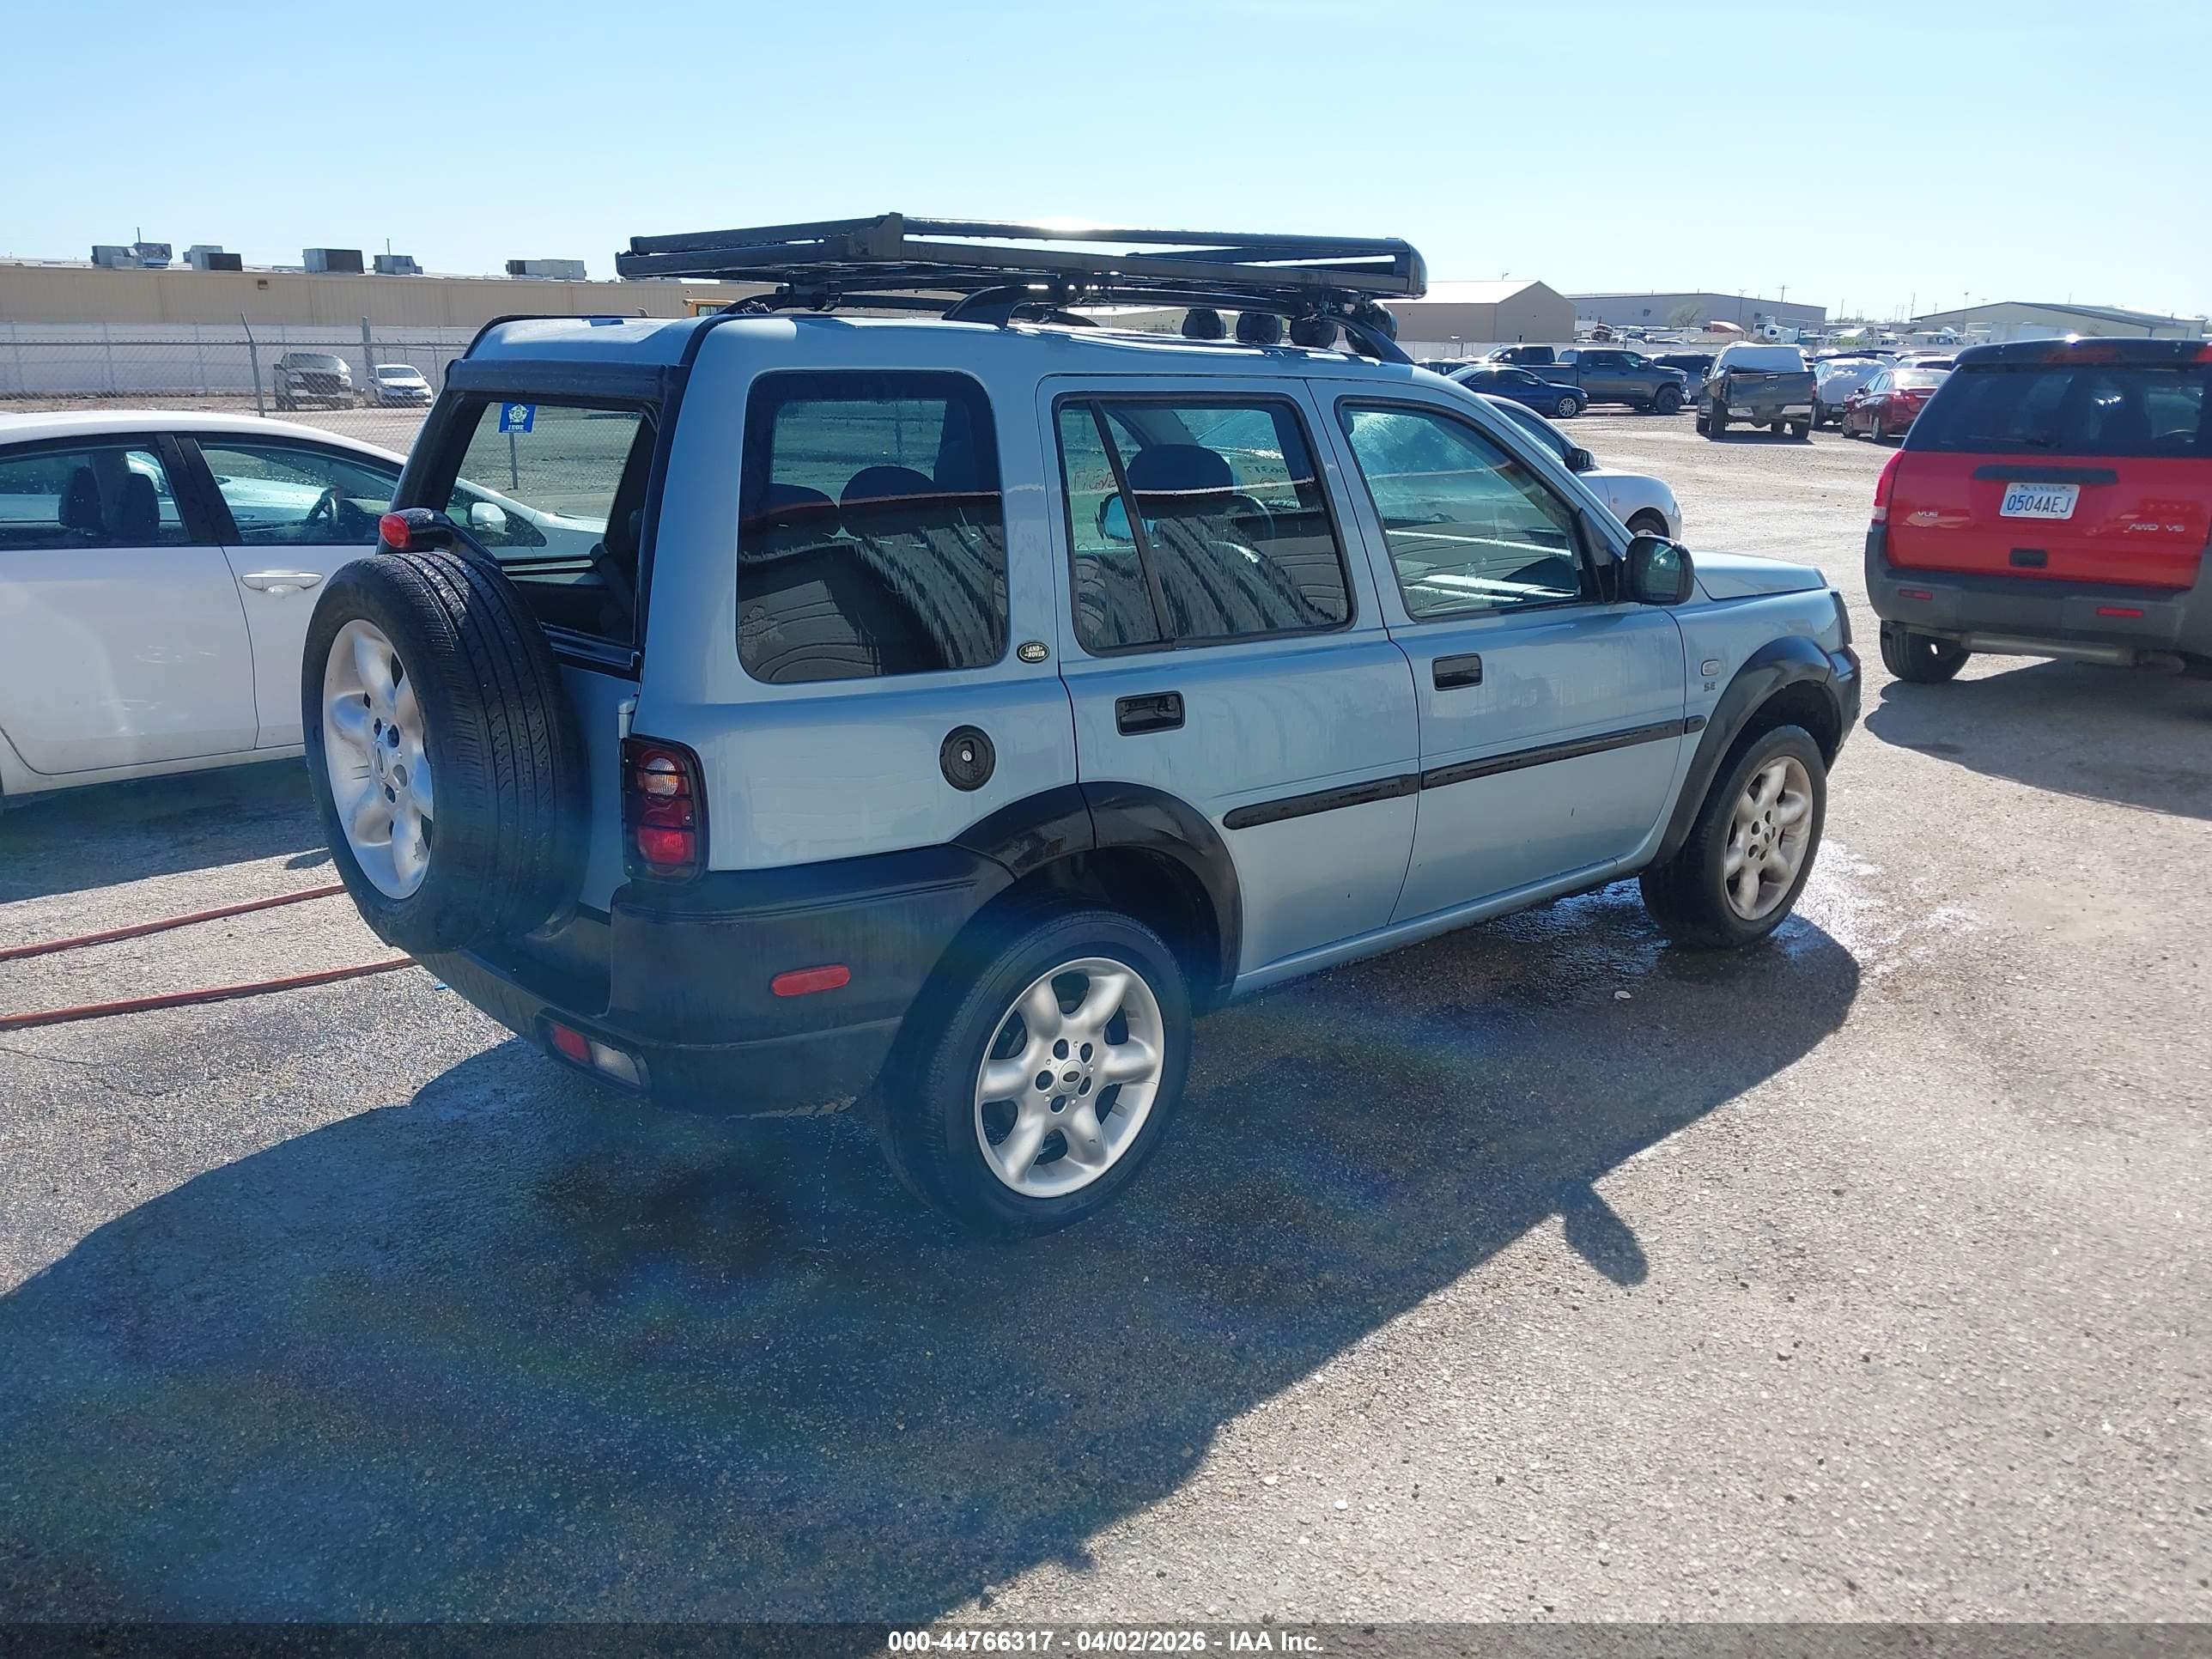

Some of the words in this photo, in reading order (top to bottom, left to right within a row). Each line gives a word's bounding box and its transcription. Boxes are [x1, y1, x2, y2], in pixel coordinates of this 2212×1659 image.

[2007, 495, 2071, 514] 0504AEJ
[1027, 650, 1046, 659] ROVER
[1704, 681, 1717, 692] SE
